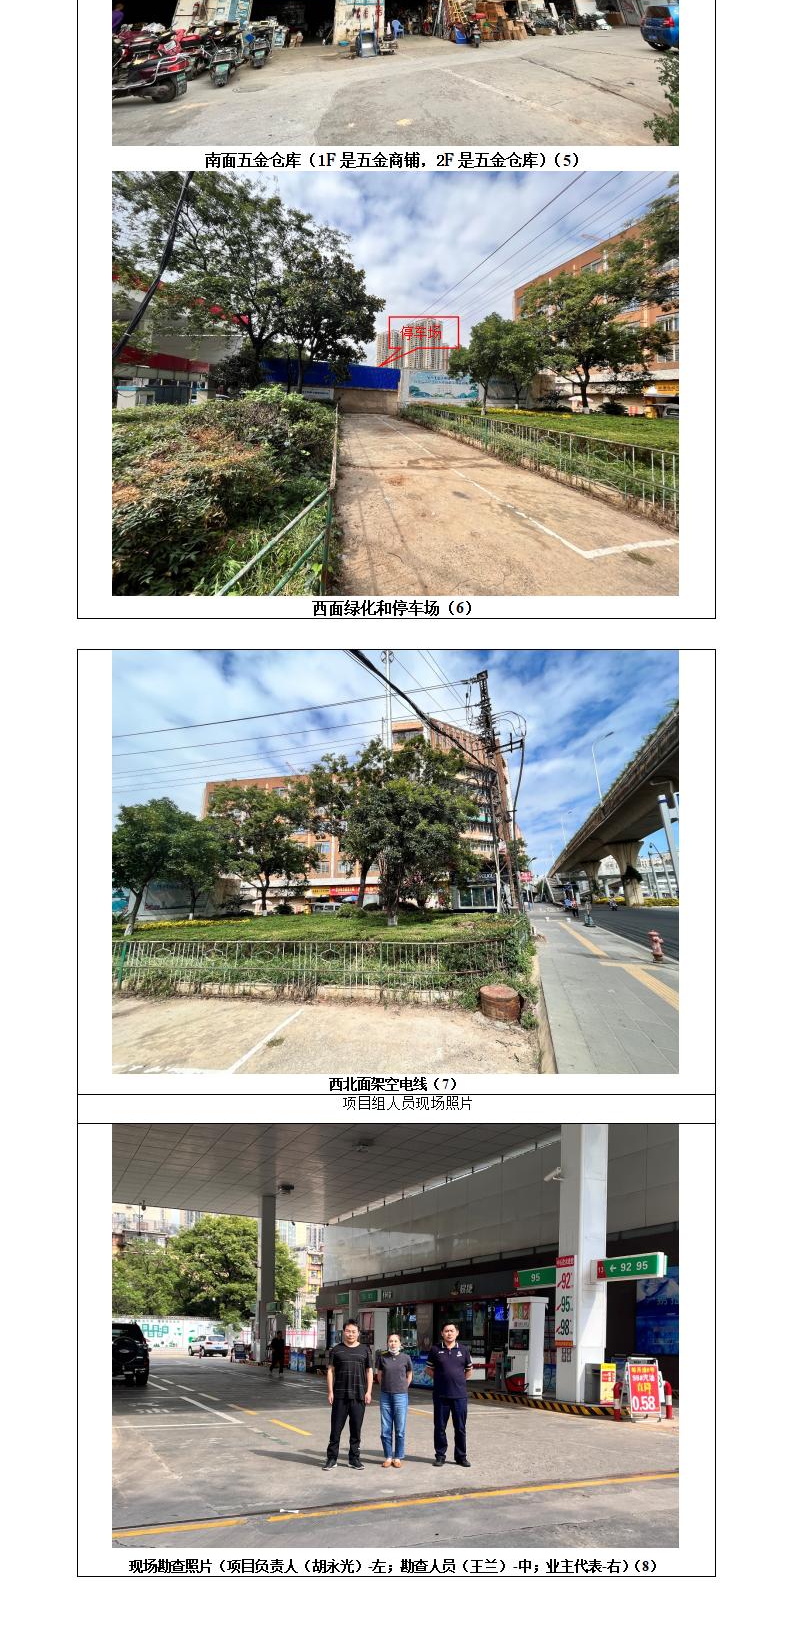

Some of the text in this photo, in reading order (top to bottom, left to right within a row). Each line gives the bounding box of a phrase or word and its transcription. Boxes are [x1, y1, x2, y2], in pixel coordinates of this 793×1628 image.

[312, 600, 471, 616] 西面绿化和停车场（6）
[329, 1077, 456, 1093] 西北面架空电线（7）
[343, 1096, 472, 1112] 项目组人员现场照片
[620, 1262, 632, 1272] 92
[636, 1261, 648, 1271] 95
[531, 1273, 541, 1282] 95
[561, 1272, 571, 1289] 92
[560, 1296, 570, 1312] 95
[560, 1320, 570, 1336] 98
[632, 1396, 656, 1411] 0.58
